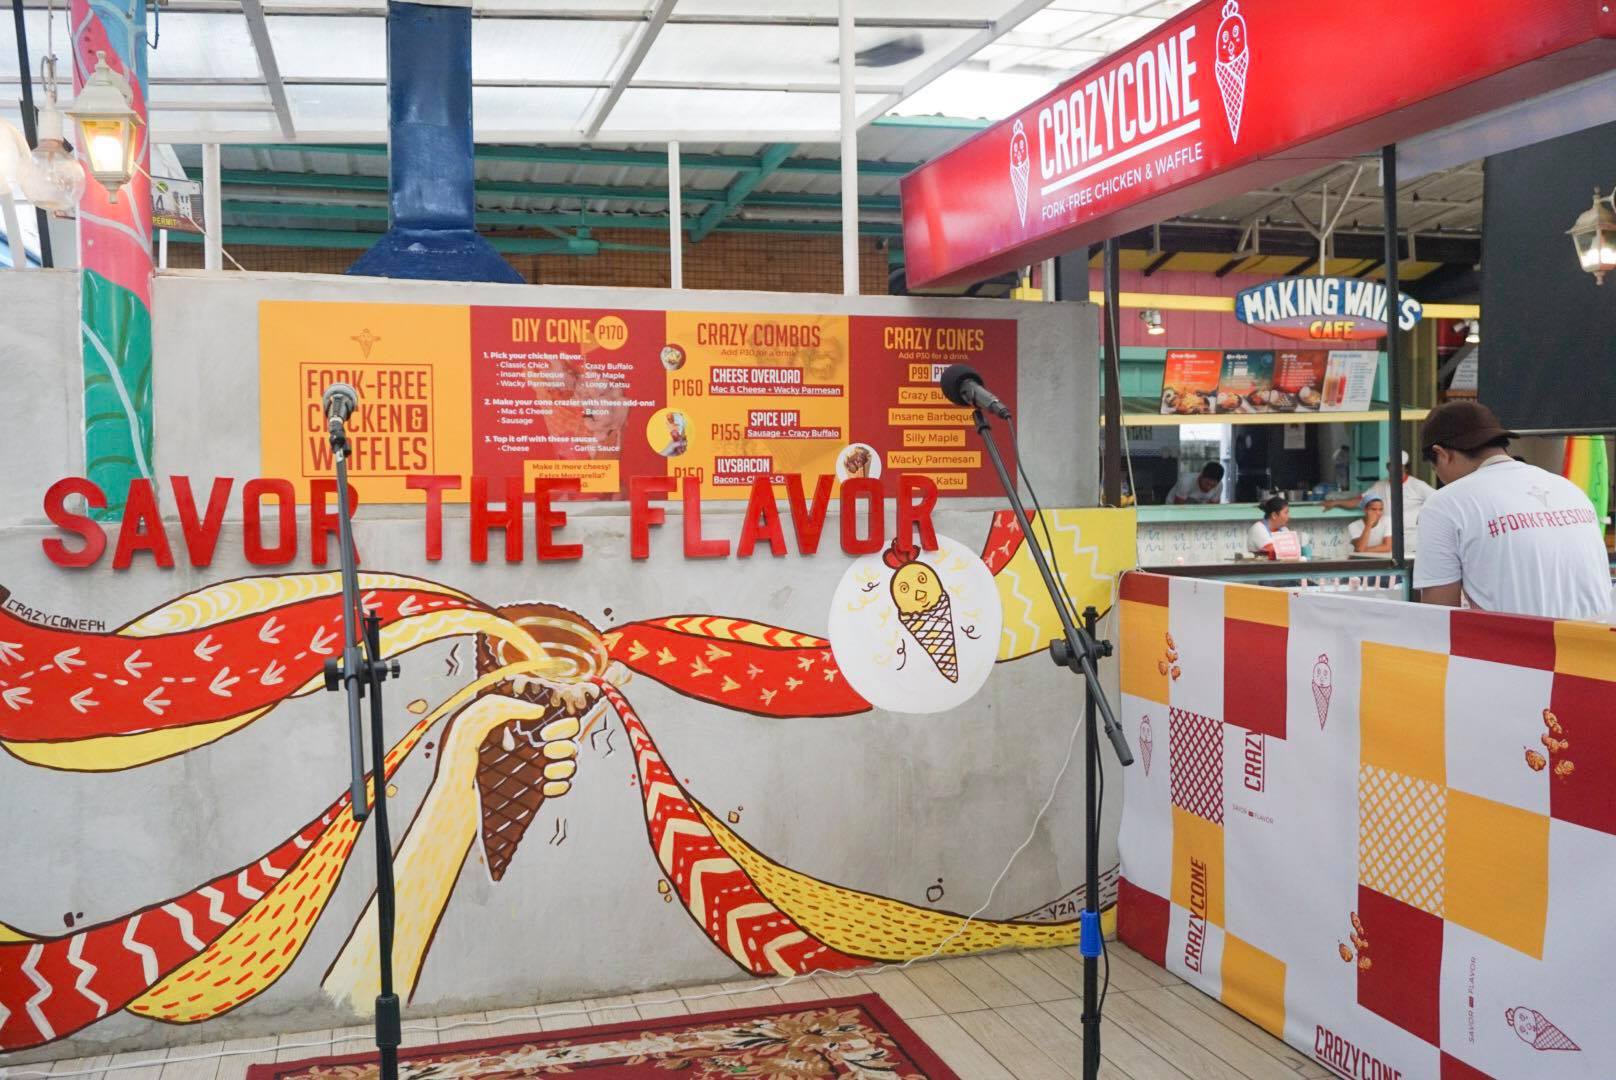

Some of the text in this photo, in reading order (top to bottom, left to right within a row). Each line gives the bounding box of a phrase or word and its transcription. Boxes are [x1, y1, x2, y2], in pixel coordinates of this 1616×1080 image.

[1038, 25, 1199, 181] CRAZYCONE
[1041, 142, 1203, 221] FORK-FREE CHICKEN & WAFFLE
[1243, 278, 1421, 332] MAKING WAVS
[511, 318, 623, 343] DIY CONE P170
[698, 323, 821, 347] CRAZY COMBOS
[1309, 321, 1357, 339] CAFE
[884, 327, 984, 351] CRAZY CONES
[755, 349, 767, 357] for
[585, 372, 625, 380] Silly Maple
[713, 368, 800, 383] CHEESE OVERLOAD
[912, 367, 929, 379] P99
[500, 380, 526, 388] Wacky
[673, 379, 702, 396] P160
[774, 386, 800, 395] Wacky
[801, 386, 841, 395] Parmesan
[492, 398, 514, 406] Make
[901, 391, 927, 401] Crazy
[308, 404, 423, 432] CCKEN &
[501, 417, 533, 425] Sausage
[751, 413, 797, 426] SPICE UP!
[892, 412, 974, 423] Insane Barbeque
[711, 424, 740, 441] P155
[747, 430, 781, 438] Sausage
[788, 430, 810, 438] Crazy
[811, 430, 839, 438] Buffalo
[906, 433, 958, 443] Silly Maple
[718, 458, 770, 473] ILYSBACON
[890, 455, 975, 465] Wacky Parmesan
[937, 477, 963, 485] Katsu
[42, 474, 939, 569] SAVOR THE FLAVOR
[6, 599, 106, 631] CRAZYCONEPH
[1184, 856, 1205, 972] CRAZYCONE
